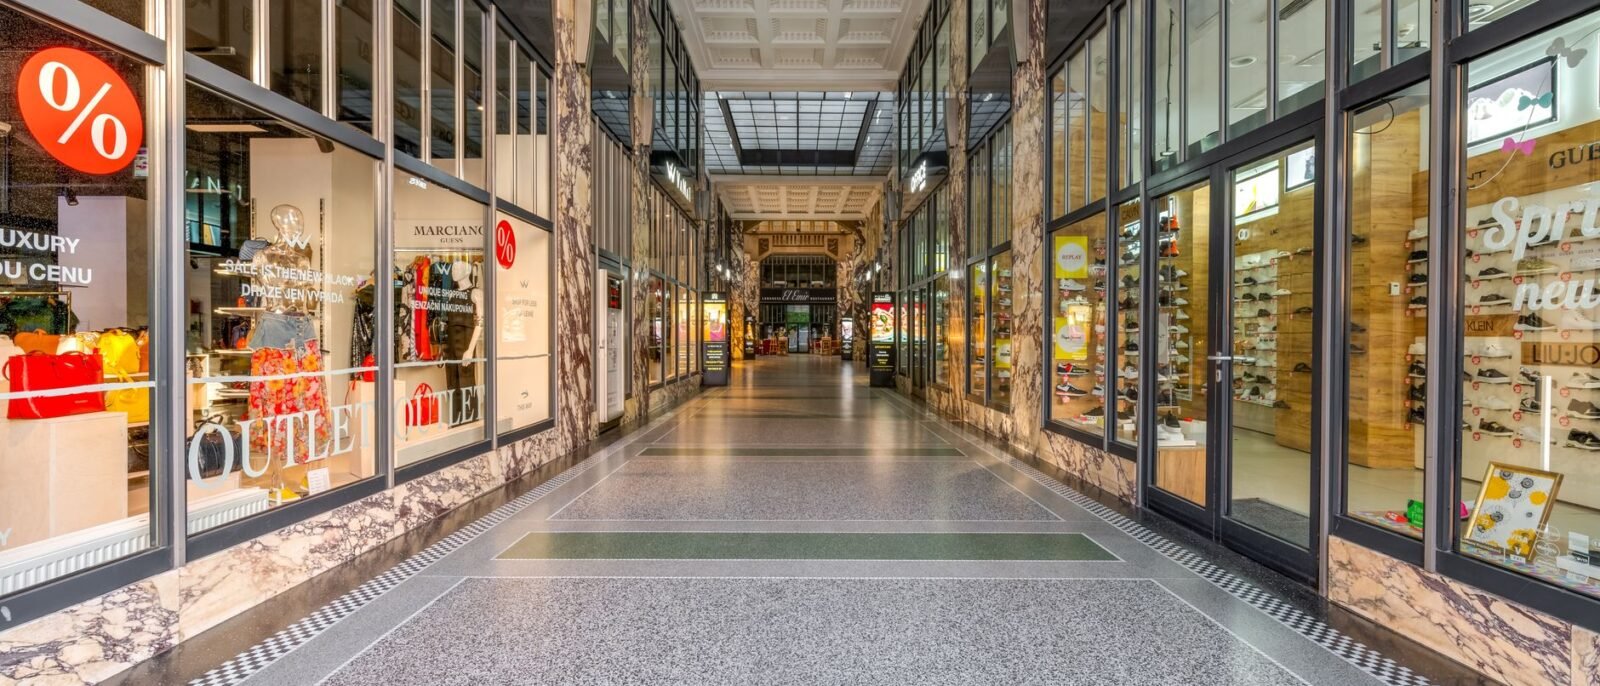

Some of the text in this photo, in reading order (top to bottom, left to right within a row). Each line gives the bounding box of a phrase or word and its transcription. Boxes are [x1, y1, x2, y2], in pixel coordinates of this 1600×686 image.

[29, 262, 92, 285] CENU
[225, 259, 258, 276] SALE
[261, 264, 276, 278] IS
[275, 267, 297, 280] THE
[297, 269, 322, 283] NEW
[285, 288, 305, 302] JEN
[1466, 320, 1494, 331] KLEIN
[394, 384, 486, 441] OUTLET
[188, 400, 376, 490] OUTLET
